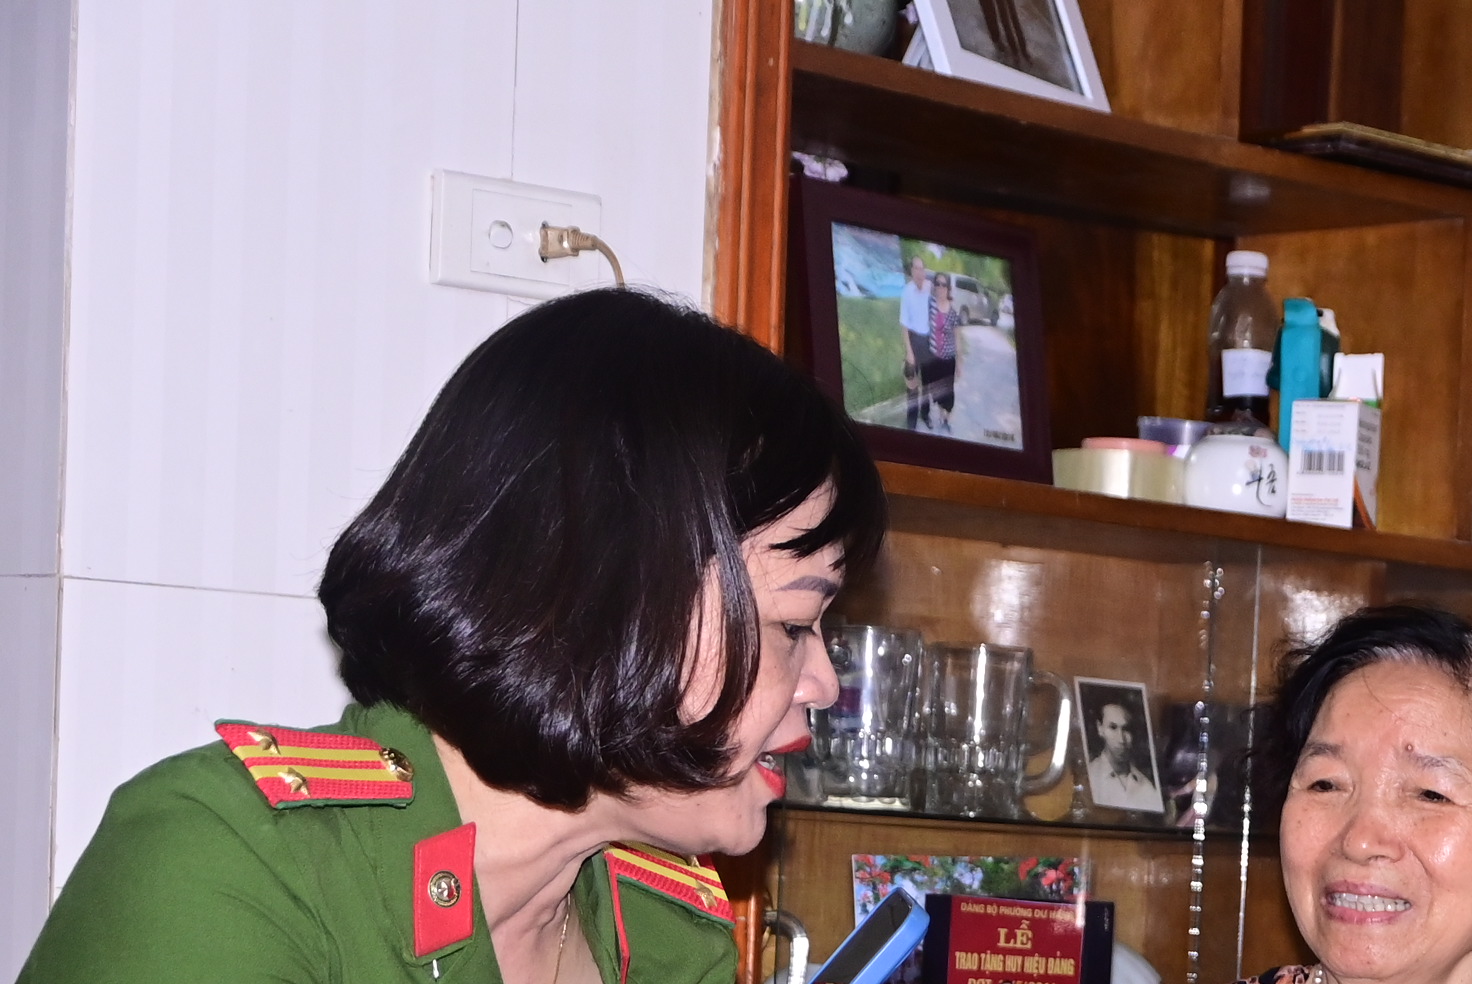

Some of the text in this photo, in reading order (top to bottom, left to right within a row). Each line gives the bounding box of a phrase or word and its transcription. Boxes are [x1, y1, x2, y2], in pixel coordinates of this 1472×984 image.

[997, 919, 1033, 949] LỄ
[955, 951, 979, 970] TRAO
[980, 950, 1004, 974] TẶNG
[1005, 955, 1023, 973] HUY
[1023, 953, 1046, 977] HIỆU
